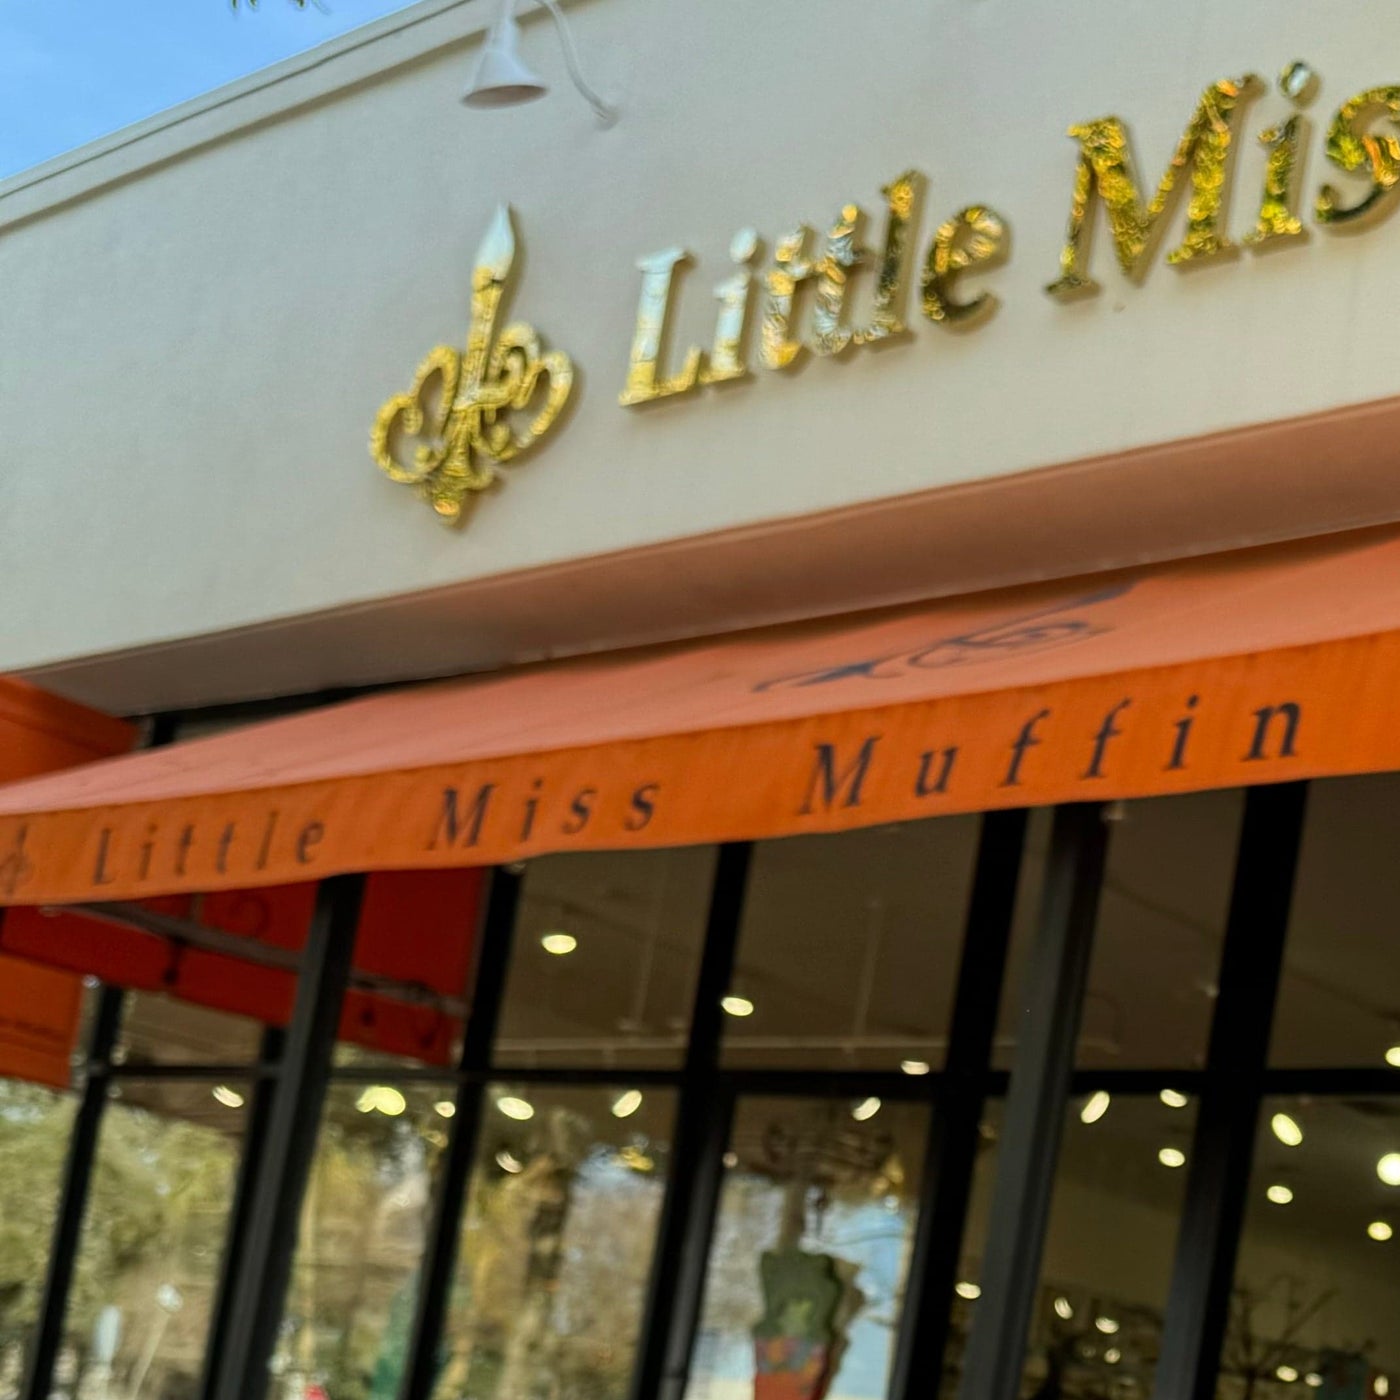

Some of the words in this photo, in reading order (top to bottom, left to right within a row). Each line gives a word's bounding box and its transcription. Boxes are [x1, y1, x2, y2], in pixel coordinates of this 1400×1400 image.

[617, 169, 1004, 406] Little
[92, 809, 326, 886] Little
[424, 779, 663, 853] Miss
[794, 693, 1304, 816] Muffin
